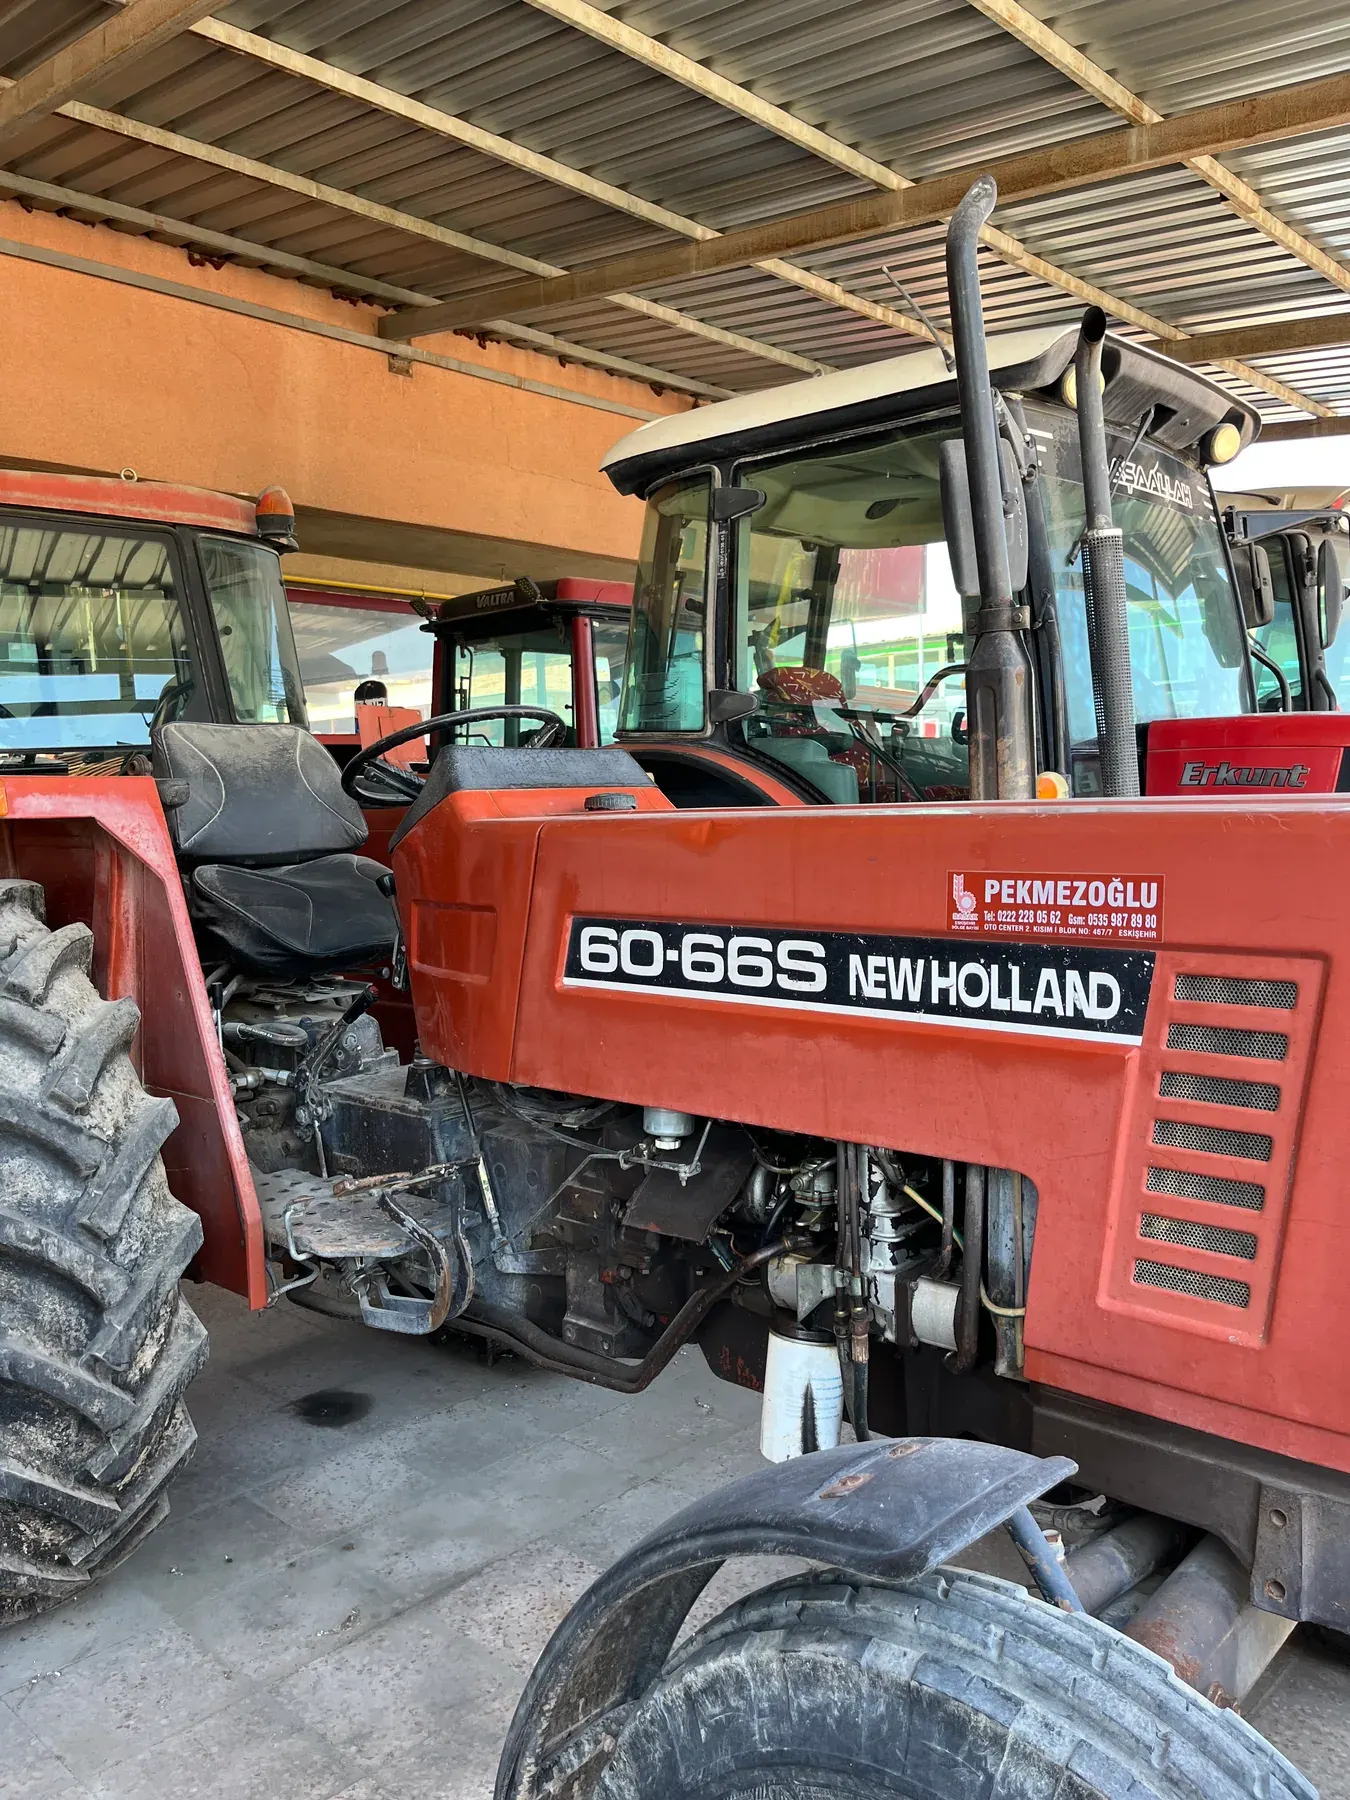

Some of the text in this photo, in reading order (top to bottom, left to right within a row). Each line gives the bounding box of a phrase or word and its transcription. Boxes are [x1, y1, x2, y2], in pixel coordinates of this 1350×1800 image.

[476, 591, 515, 609] VALTRA
[1179, 761, 1309, 788] Erkunt
[984, 877, 1158, 908] PEKMEZOĞLU
[984, 909, 1061, 925] Tel: 0222 228 05 62
[1068, 913, 1157, 929] Gsm: 0535 987 89 80
[984, 923, 997, 931] OTO
[998, 924, 1024, 933] CENTER
[1025, 925, 1032, 933] 2.
[1059, 926, 1077, 935] BLOK
[1078, 927, 1091, 935] NO:
[1092, 928, 1113, 936] 467/7
[1118, 929, 1157, 939] ESKİŞEHİR
[580, 926, 1121, 1021] 60-66S NEW HOLLAND
